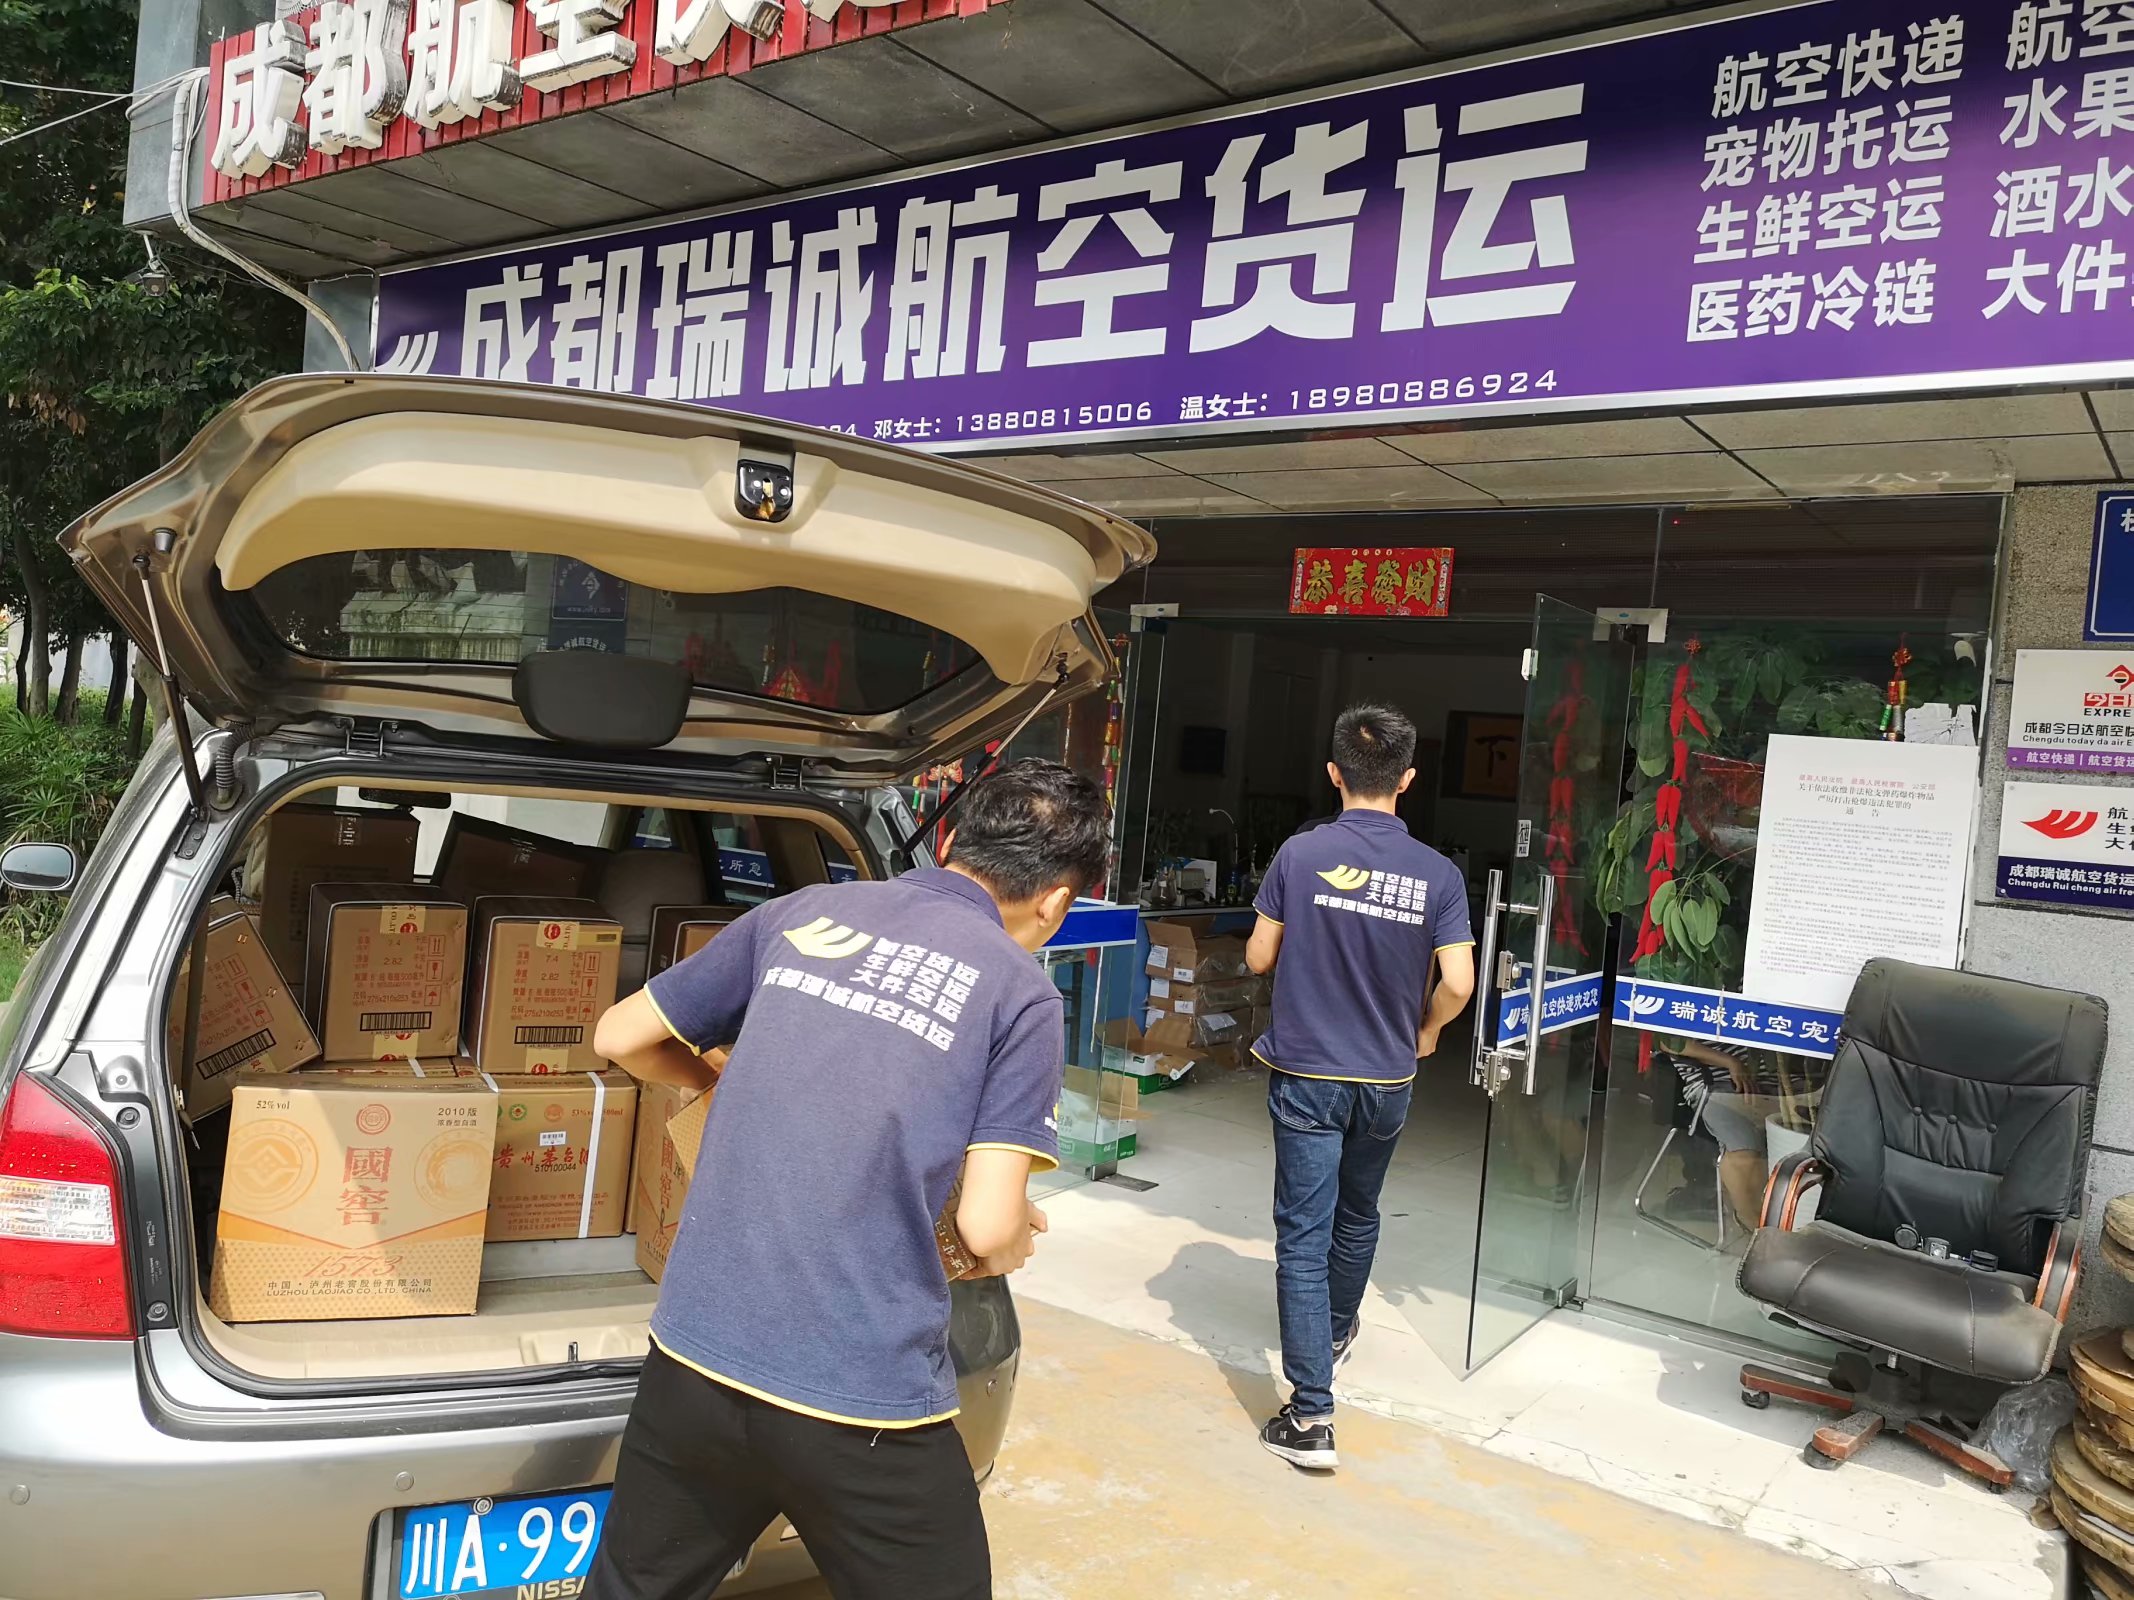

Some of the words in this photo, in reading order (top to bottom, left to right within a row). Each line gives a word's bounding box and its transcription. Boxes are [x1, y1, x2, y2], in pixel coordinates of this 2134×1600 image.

[2005, 0, 2134, 71] 航空
[1711, 14, 1965, 119] 航空快递
[1999, 67, 2134, 149] 水果
[1701, 95, 1953, 192] 宠物托运
[1693, 175, 1945, 264] 生鲜空运
[1989, 156, 2134, 238] 酒水
[460, 83, 1588, 400] 成都瑞诚航空货运
[1686, 258, 1937, 343] 医药冷链
[1981, 239, 2126, 320] 大件
[956, 402, 1151, 432] 13880815006
[1289, 368, 1558, 410] 18980886924
[2084, 693, 2134, 707] 今日
[2022, 734, 2064, 746] Chengdu
[2067, 735, 2095, 747] today
[2097, 736, 2109, 746] da
[2111, 737, 2125, 747] air
[2026, 751, 2075, 765] 航空快递
[1369, 881, 1427, 901] 生鲜空运
[1370, 870, 1428, 890] 航空货运
[2008, 877, 2051, 891] Chengdu
[2053, 881, 2070, 891] Rui
[2071, 883, 2101, 895] cheng
[2103, 886, 2117, 895] air
[2009, 864, 2134, 887] 成都瑞诚航空货运
[1313, 894, 1424, 925] 成都瑞诚航空货运
[1365, 891, 1425, 912] 大件空运
[862, 954, 971, 1003] 生鲜空运
[872, 937, 980, 987] 航空货运
[762, 967, 955, 1051] 成都瑞诚航空货运
[849, 968, 962, 1023] 大件空运
[1669, 1000, 1840, 1043] 瑞诚航空宠
[256, 1100, 274, 1110] 52%
[277, 1100, 290, 1110] vol
[336, 1146, 393, 1226] 國窖
[304, 1255, 403, 1278] 1573
[267, 1289, 308, 1297] LUZHOU
[312, 1288, 353, 1296] LAOJIAO
[402, 1286, 432, 1294] CHINA
